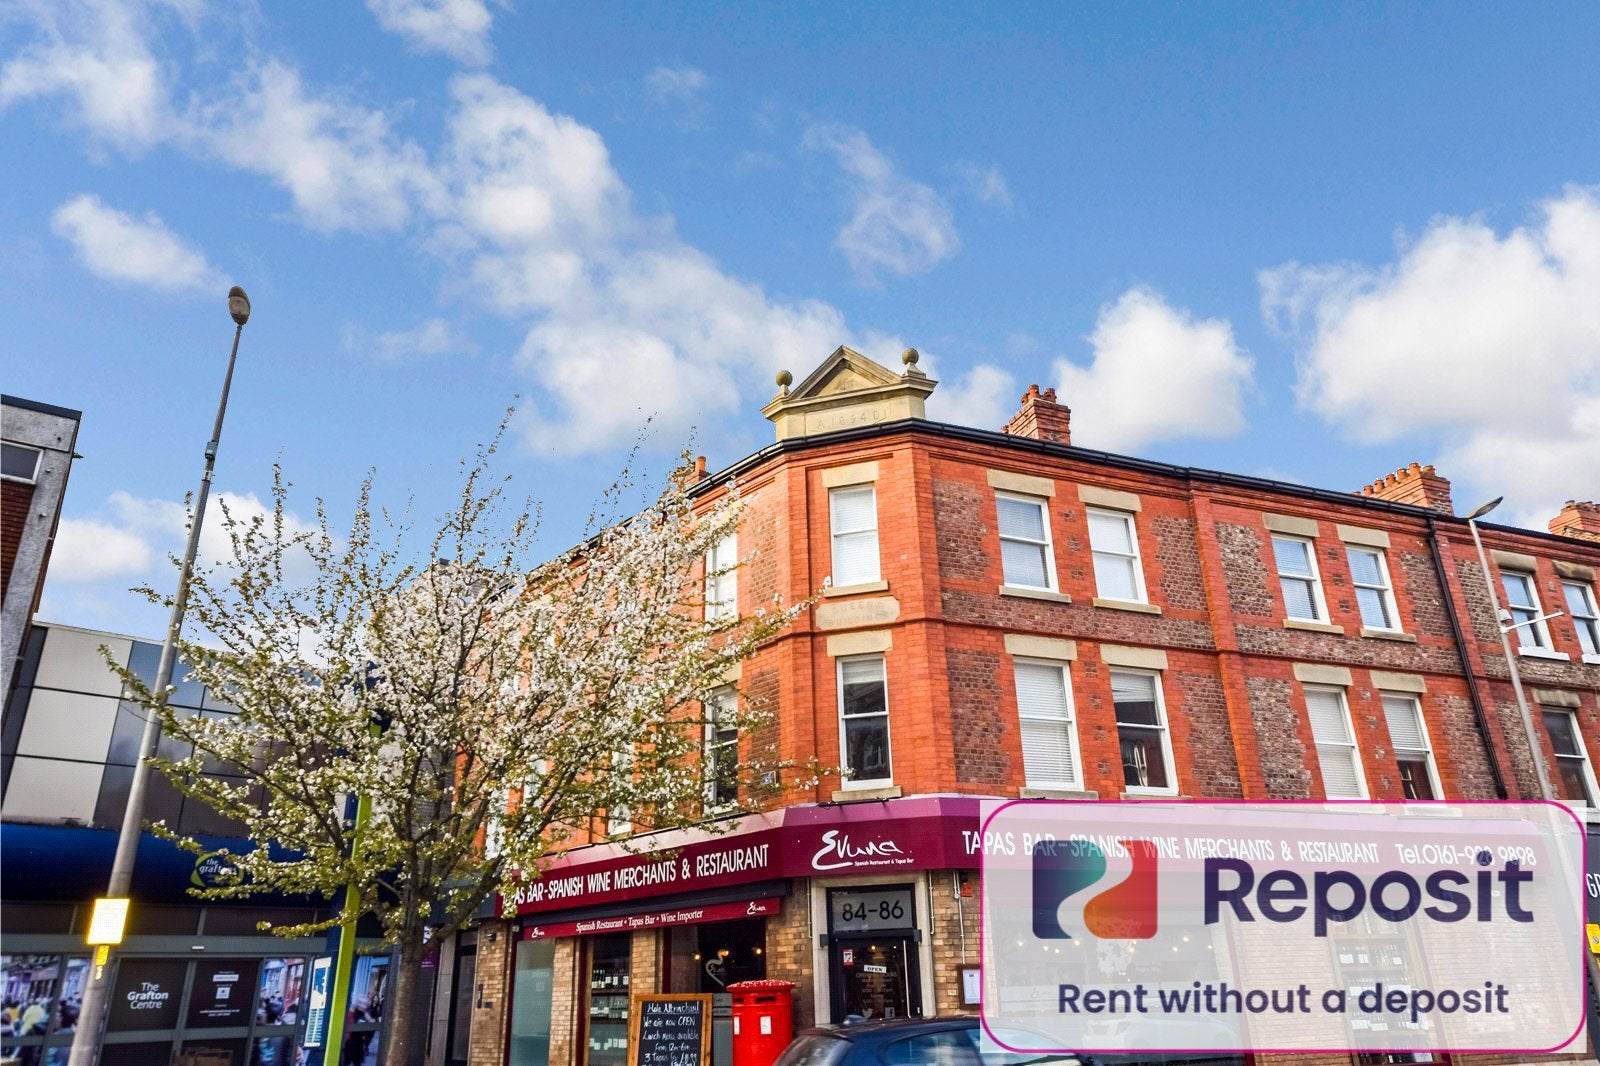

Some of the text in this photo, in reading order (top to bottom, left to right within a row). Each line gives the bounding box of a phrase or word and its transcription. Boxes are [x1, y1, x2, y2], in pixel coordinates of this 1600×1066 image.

[811, 829, 904, 871] Evuna
[962, 831, 1016, 856] TAPAS
[1139, 836, 1181, 859] WINE
[1184, 837, 1275, 862] MERCHANTS
[1280, 840, 1294, 861] &
[1297, 840, 1381, 864] RESTAURANT
[587, 870, 611, 894] WINE
[614, 860, 677, 890] MERCHANTS
[681, 858, 691, 880] &
[696, 843, 769, 877] RESTAURANT
[842, 900, 904, 921] 84-86
[576, 910, 704, 933] Spanish Restaurant Tapas Bar Wine Importer
[141, 982, 160, 992] The
[127, 990, 169, 1001] Grafton
[130, 1000, 163, 1010] Centre
[677, 1016, 696, 1027] OPEN
[644, 1053, 651, 1062] 3
